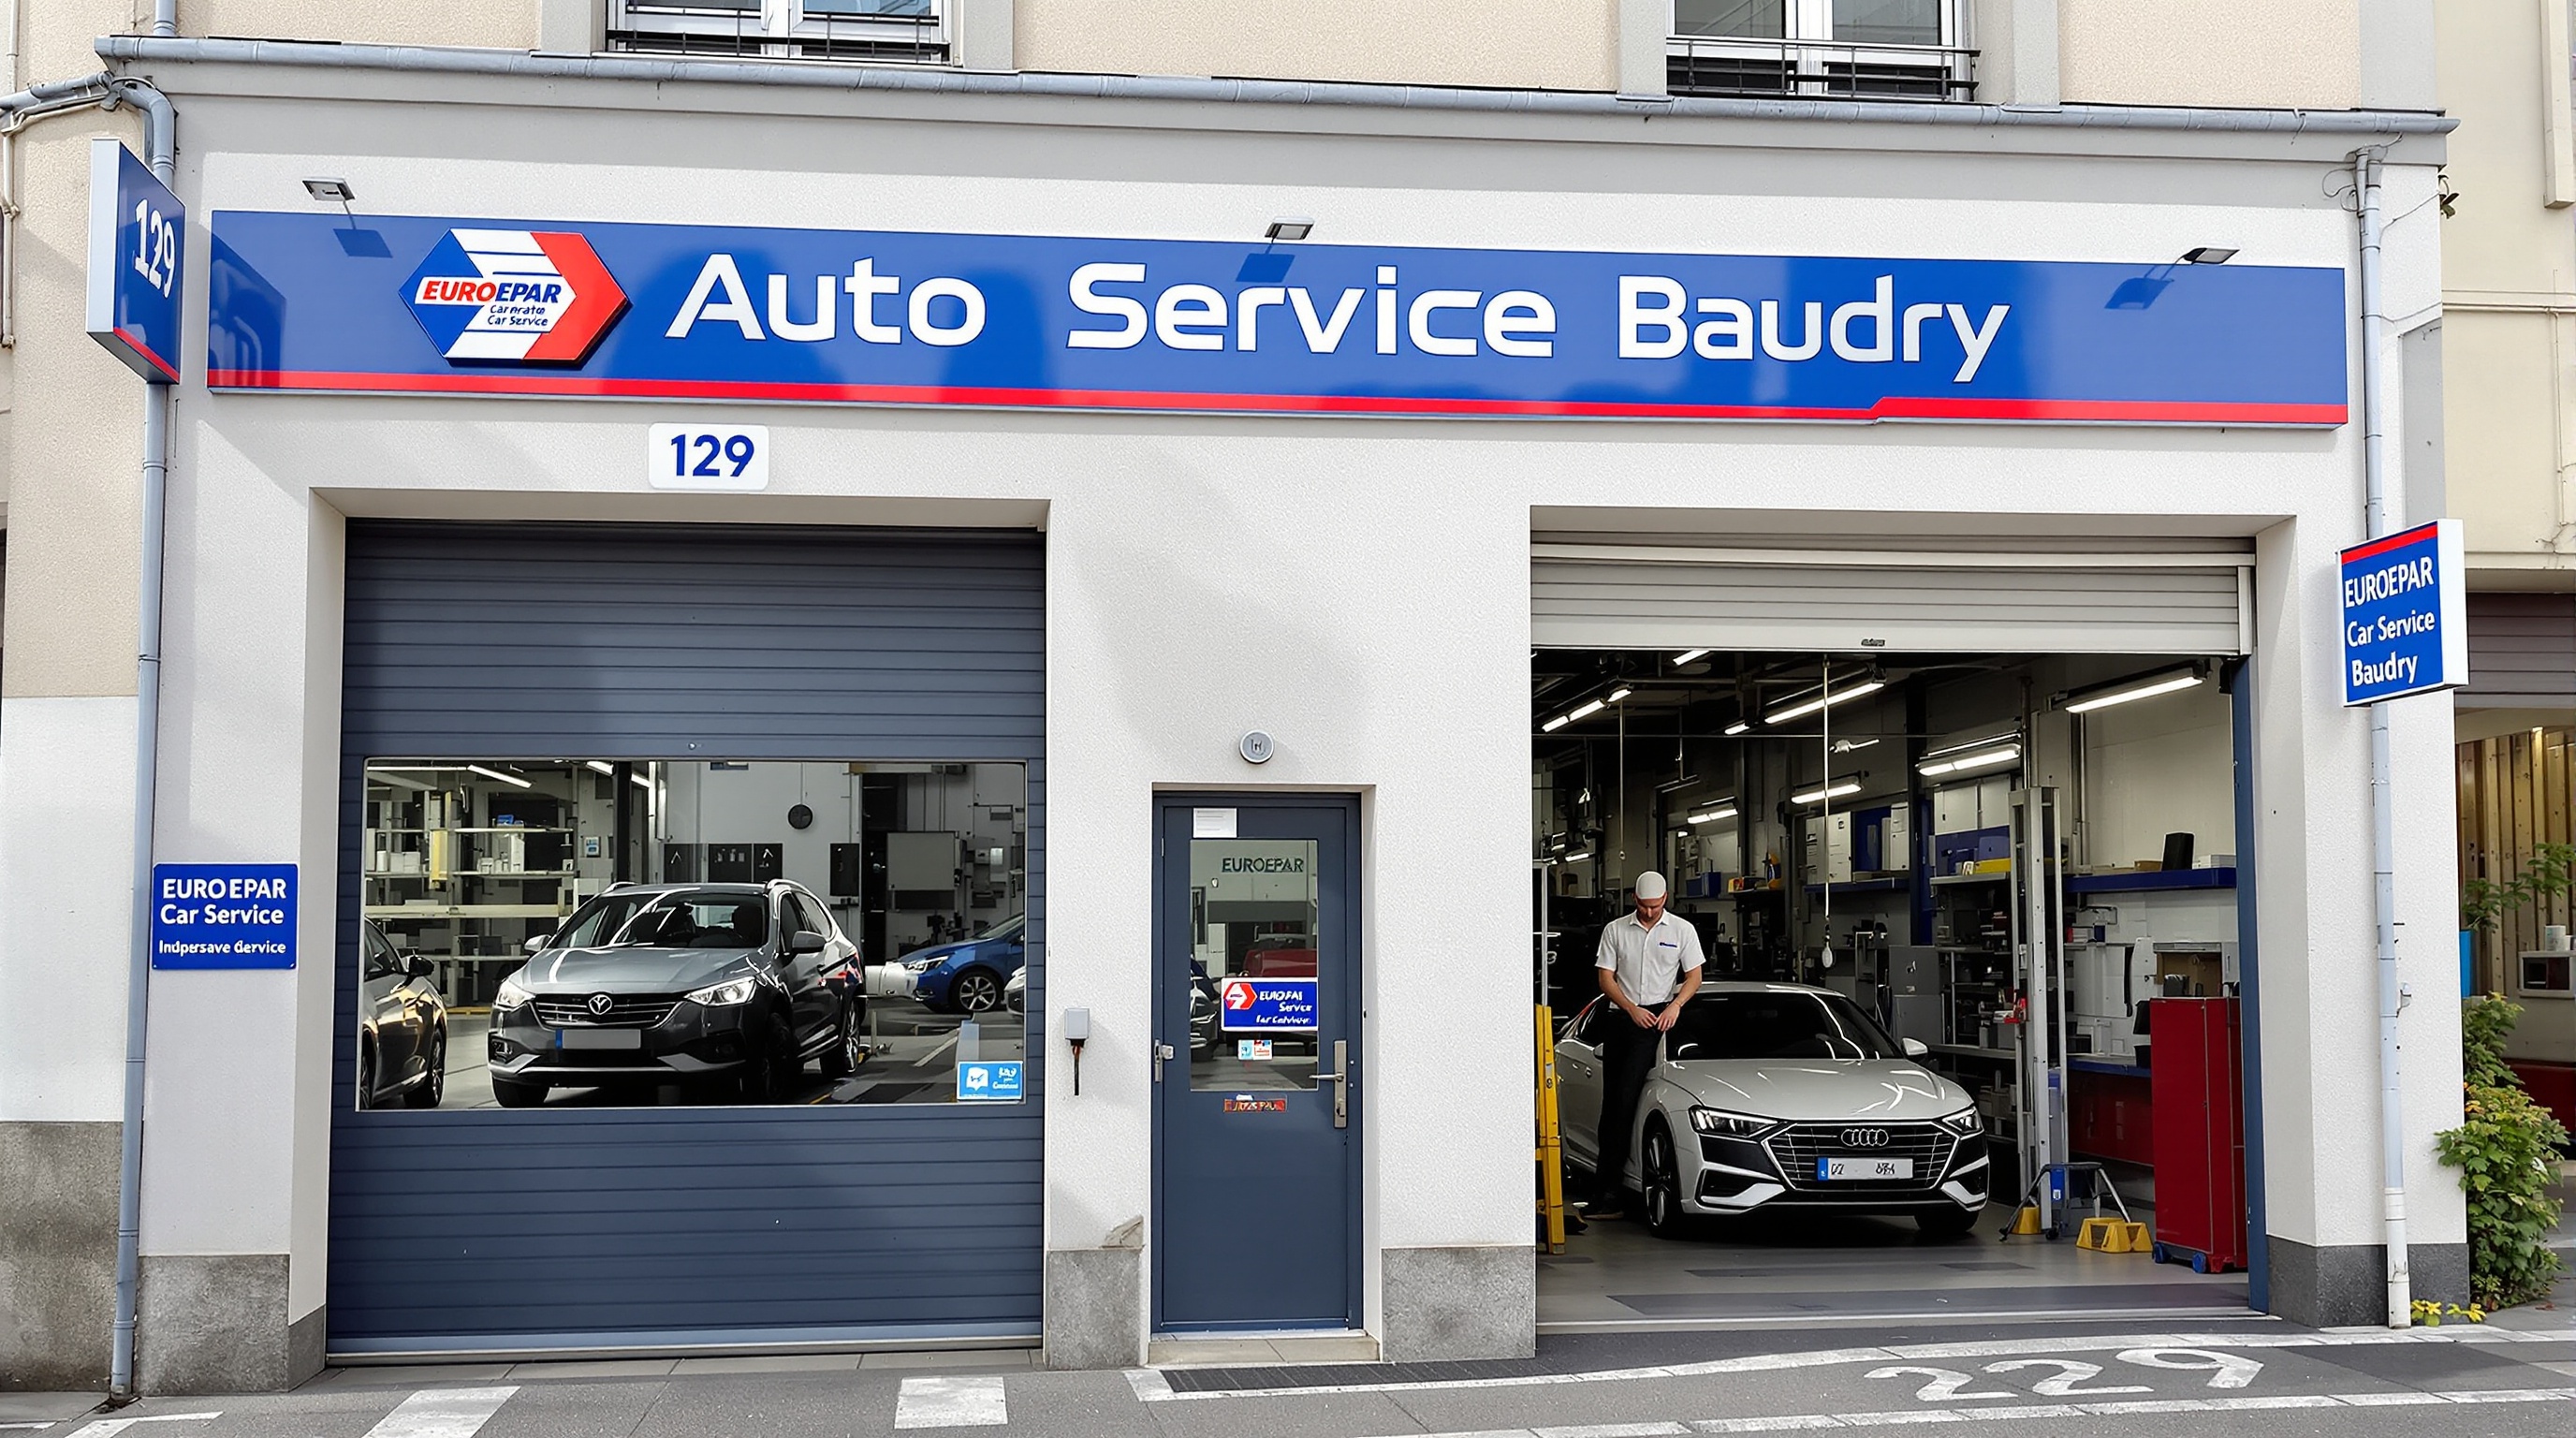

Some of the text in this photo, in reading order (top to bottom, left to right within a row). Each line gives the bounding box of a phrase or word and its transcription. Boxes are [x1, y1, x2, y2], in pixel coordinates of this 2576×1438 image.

[135, 198, 175, 298] 129
[422, 280, 562, 303] EUROEPAR
[488, 315, 506, 326] Car
[664, 253, 2011, 383] Auto Service Baudry
[670, 433, 754, 477] 129
[2344, 556, 2434, 608] EUROEPAR
[2347, 609, 2435, 647] Car Service
[2351, 652, 2418, 687] Baudry
[160, 904, 284, 924] Car Service
[1864, 1348, 2263, 1401] 229
